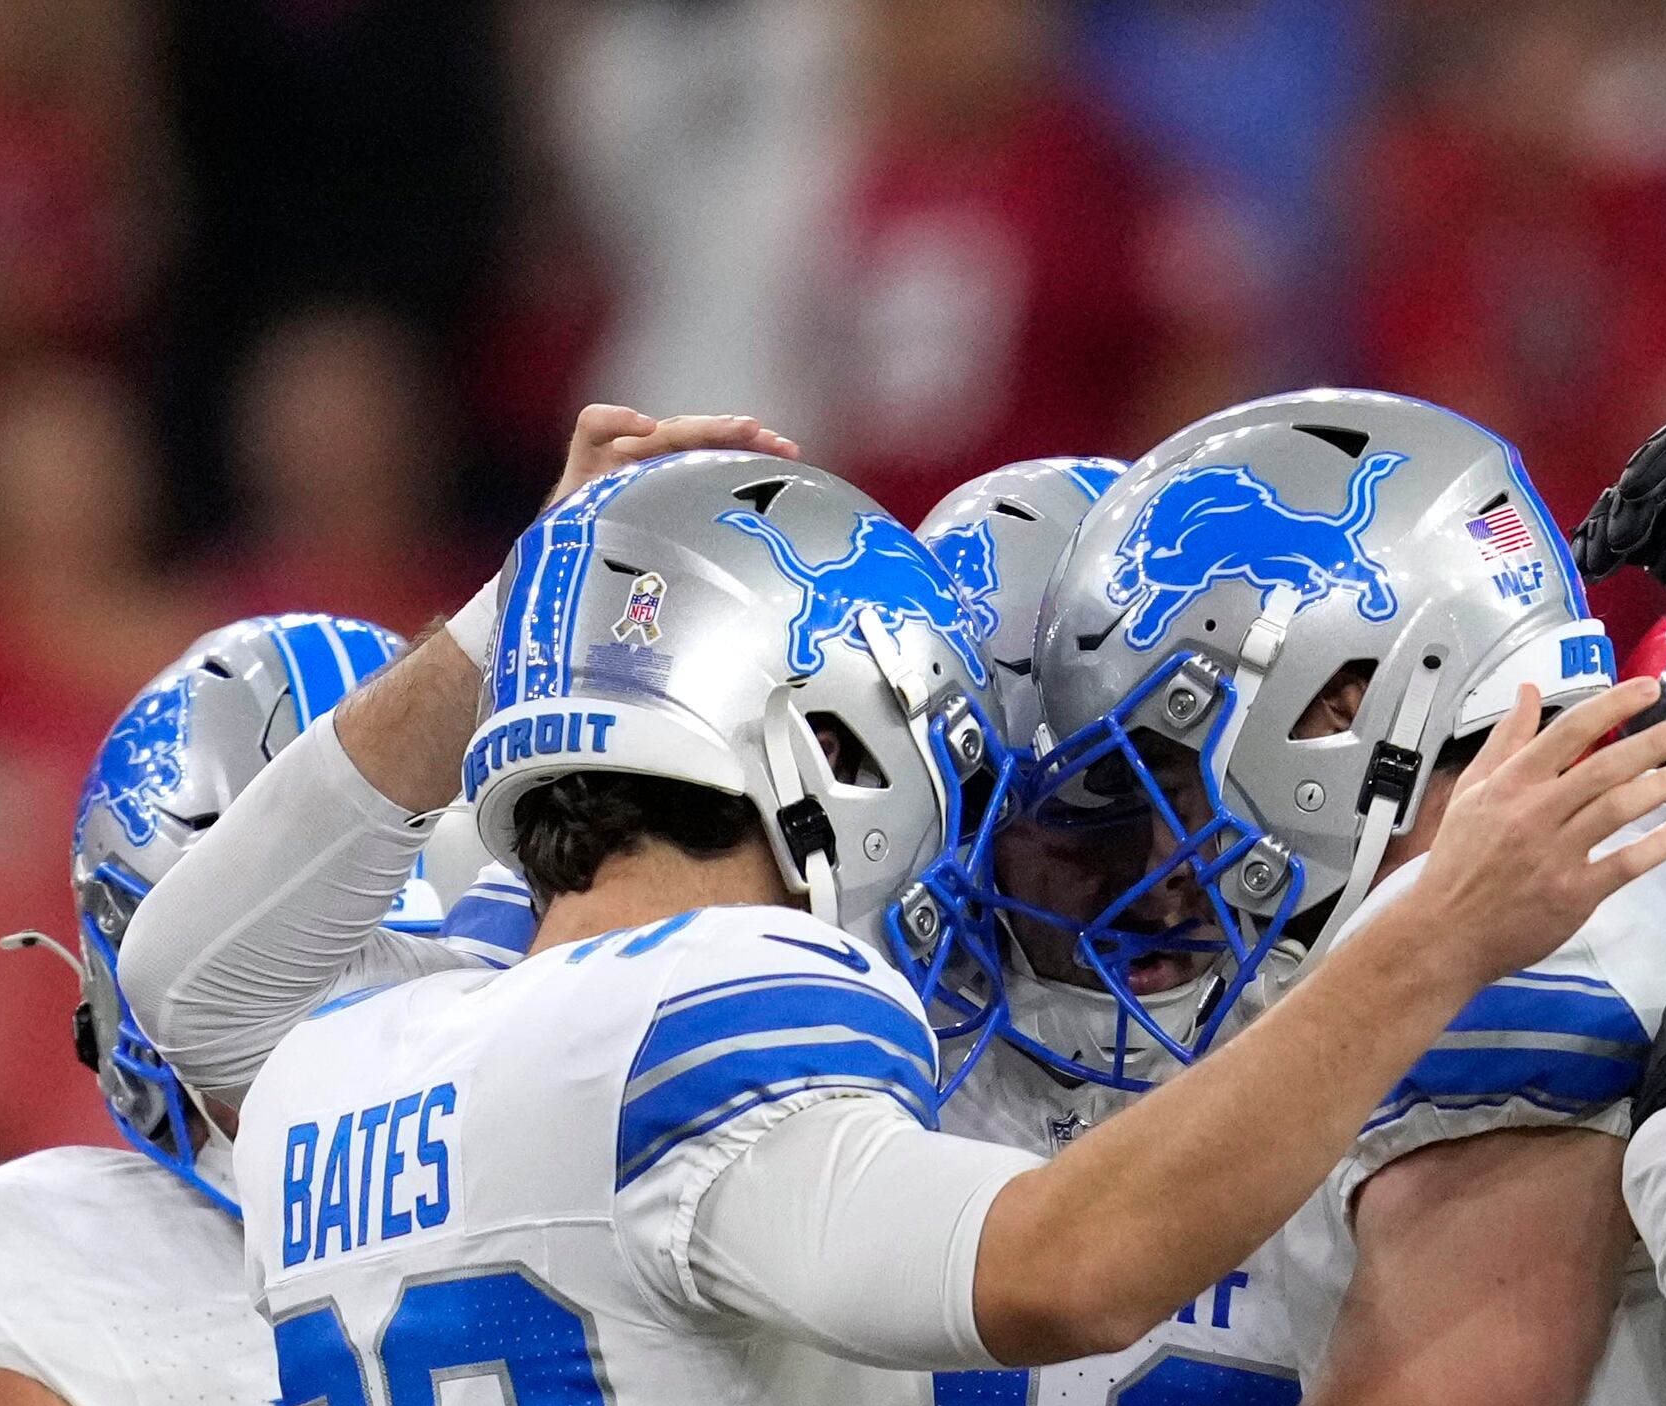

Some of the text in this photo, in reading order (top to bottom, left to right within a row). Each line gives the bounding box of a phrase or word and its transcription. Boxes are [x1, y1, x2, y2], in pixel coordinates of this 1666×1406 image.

[1492, 561, 1545, 600] WCF
[629, 604, 654, 623] NFL
[464, 712, 617, 803] DETROIT
[283, 1081, 457, 1269] BATES
